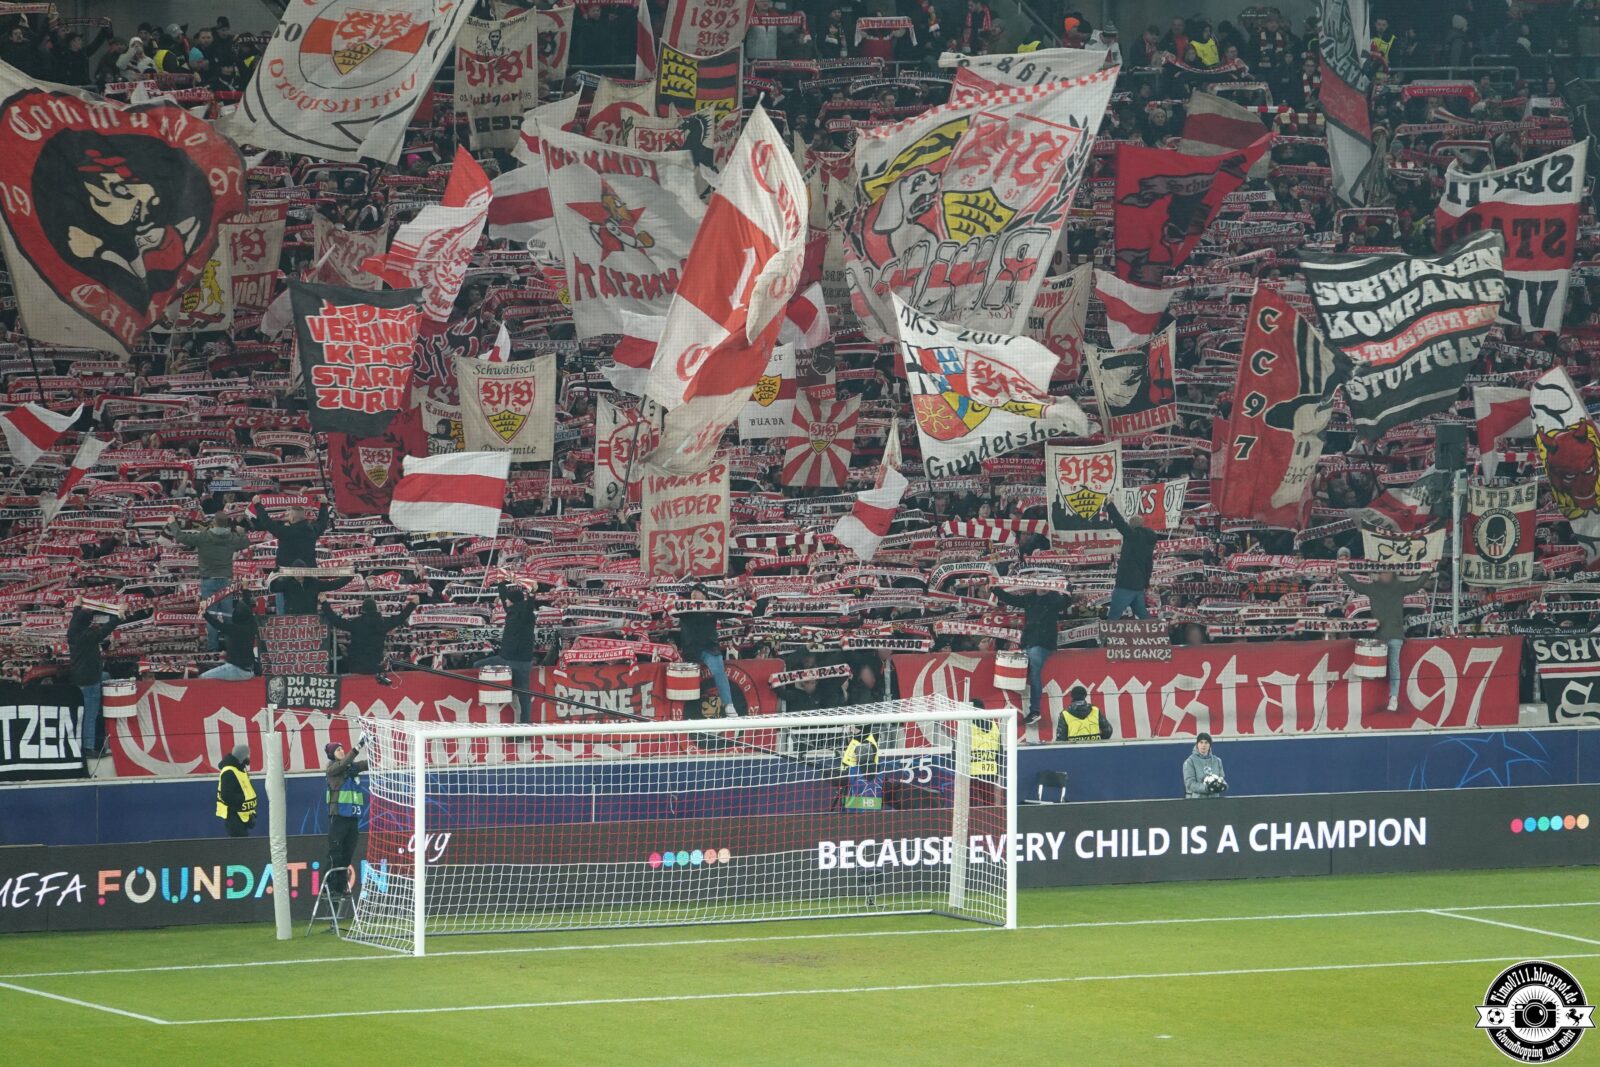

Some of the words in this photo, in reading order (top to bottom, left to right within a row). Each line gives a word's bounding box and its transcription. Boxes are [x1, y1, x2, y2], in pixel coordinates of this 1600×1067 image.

[690, 7, 741, 29] 1893
[9, 97, 208, 148] Commando
[1313, 246, 1503, 307] SCHWABEN
[319, 299, 417, 325] JEDER
[472, 362, 536, 376] Schwäbisch
[479, 379, 535, 406] VfB
[650, 494, 722, 525] WIEDER
[1162, 482, 1186, 513] 07
[760, 555, 808, 566] STUTTGART
[772, 602, 832, 612] STUTTGART
[258, 624, 328, 640] VERBANNTE
[266, 615, 320, 627] JEDER
[266, 640, 322, 651] KEHRT
[847, 638, 923, 650] COMMANDO
[1106, 649, 1131, 659] UMS
[1133, 648, 1173, 660] GANZE
[287, 676, 305, 686] DU
[309, 677, 337, 688] BIST
[287, 686, 337, 699] IMMER
[1404, 645, 1504, 730] 97
[554, 682, 635, 718] SZENE
[640, 681, 656, 717] E
[0, 705, 84, 760] TZEN
[900, 758, 932, 784] 35
[818, 838, 955, 869] BECAUSE
[969, 831, 1066, 864] EVERY
[1074, 825, 1170, 859] CHILD
[1180, 825, 1208, 855] IS
[1216, 824, 1240, 853] A
[1248, 817, 1427, 852] CHAMPION
